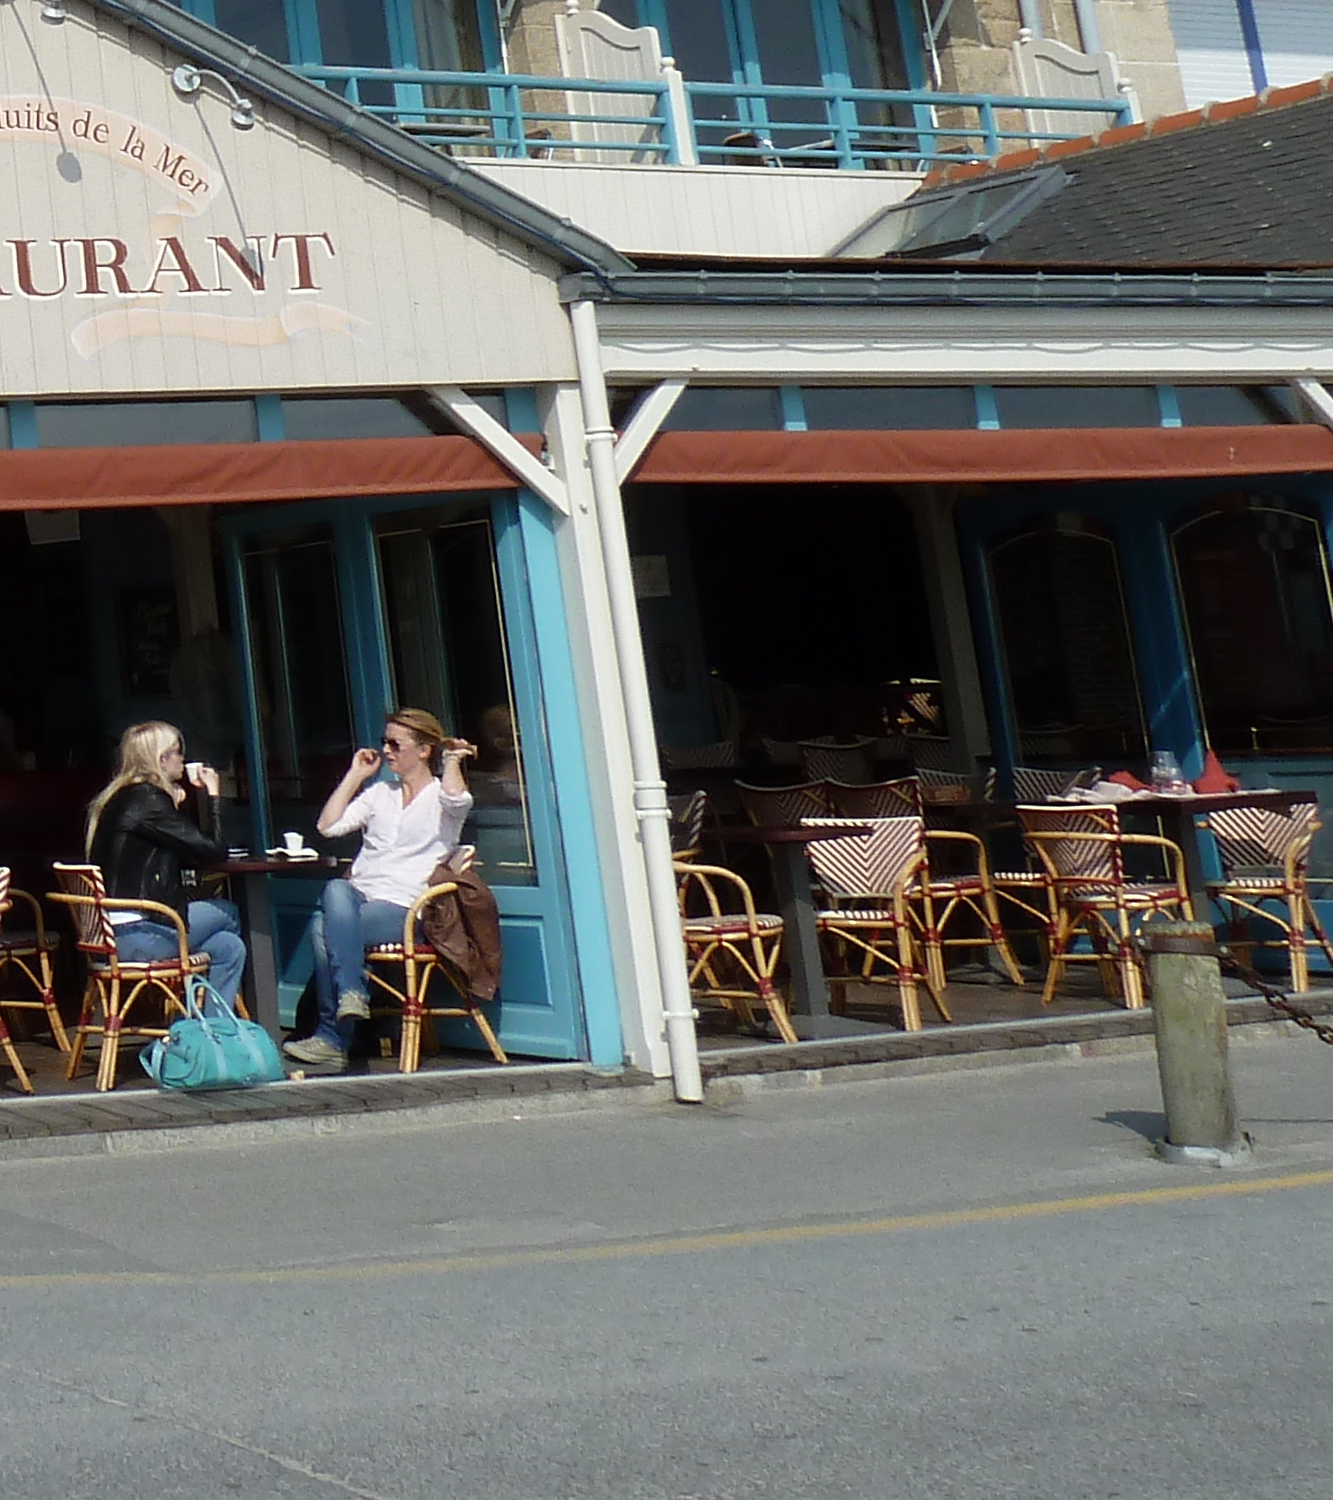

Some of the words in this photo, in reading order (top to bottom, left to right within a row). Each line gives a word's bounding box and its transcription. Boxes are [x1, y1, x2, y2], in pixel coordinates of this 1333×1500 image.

[72, 110, 109, 144] de
[119, 125, 145, 162] la
[152, 144, 210, 197] Mer
